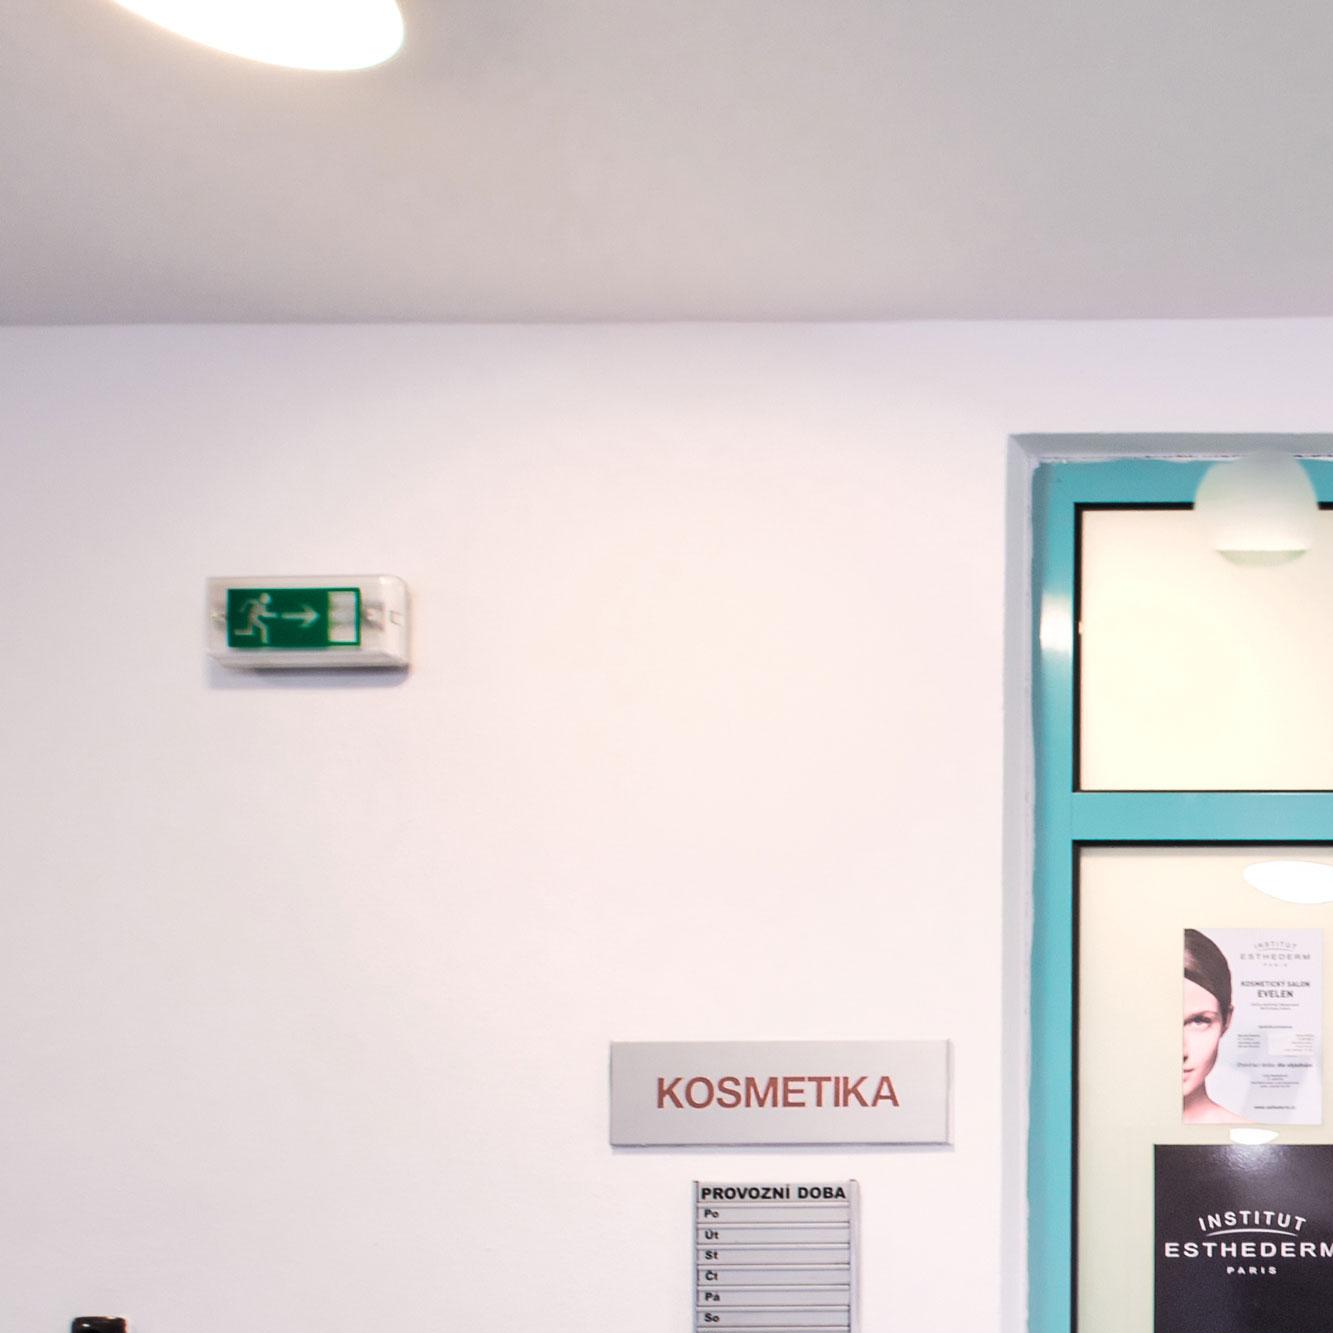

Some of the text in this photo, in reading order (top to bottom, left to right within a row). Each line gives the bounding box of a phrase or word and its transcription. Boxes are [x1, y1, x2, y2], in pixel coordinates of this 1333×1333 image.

[1256, 989, 1295, 999] EVELEN
[656, 1075, 901, 1109] KOSMETIKA
[701, 1184, 847, 1200] PROVOZNÍ DOBA
[703, 1208, 720, 1219] Po
[1198, 1210, 1307, 1231] INSTITUT
[704, 1249, 719, 1260] St
[1226, 1266, 1277, 1275] PARIS
[703, 1312, 721, 1323] So
